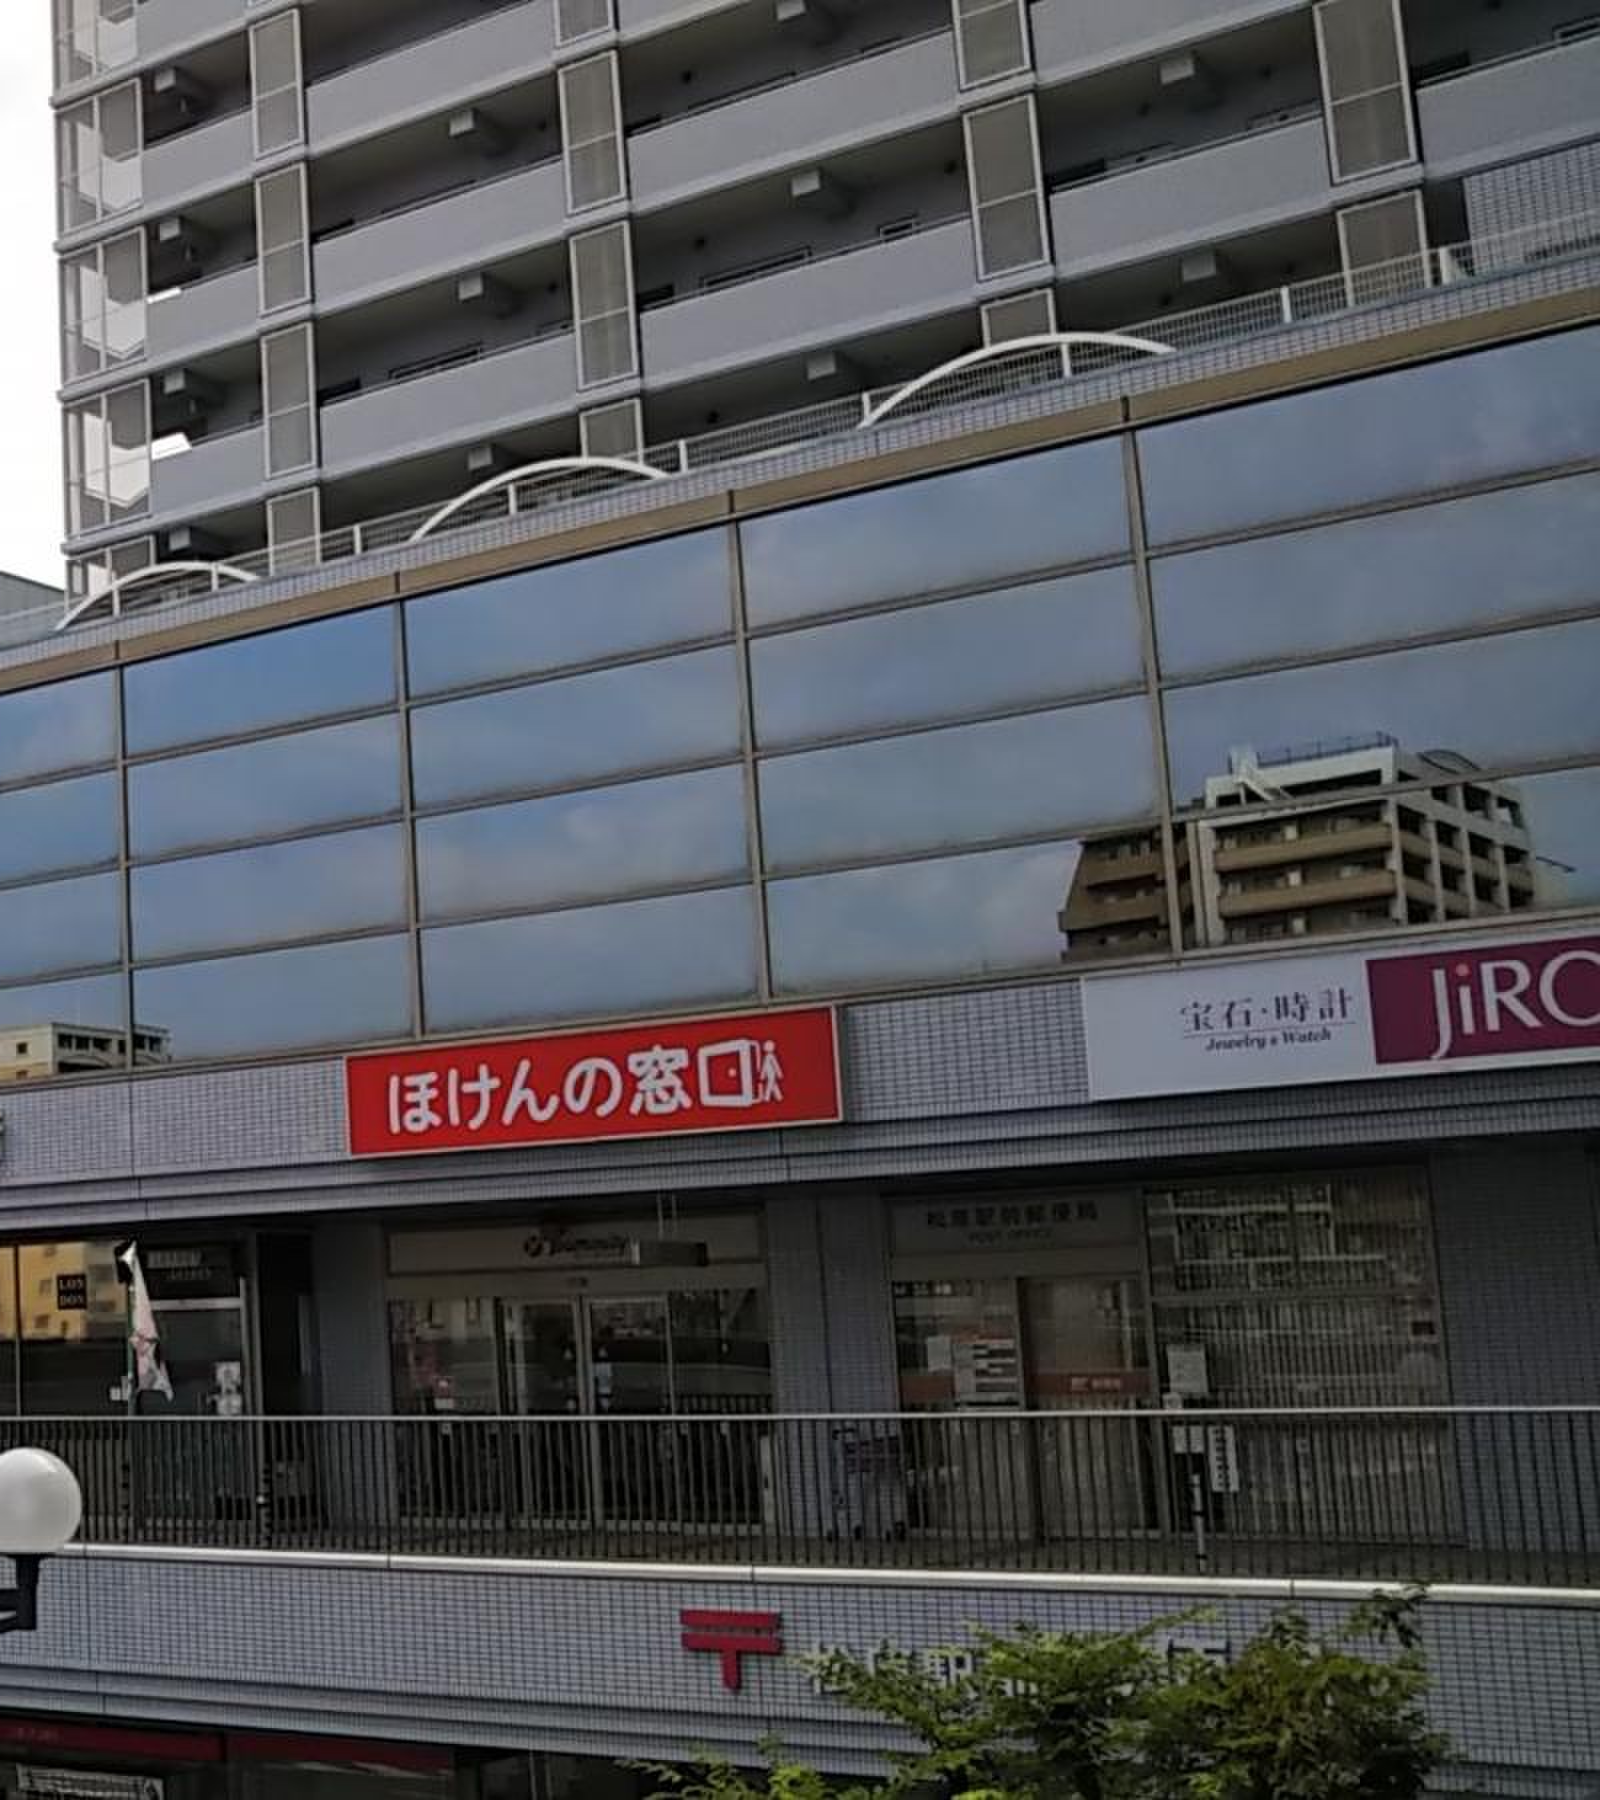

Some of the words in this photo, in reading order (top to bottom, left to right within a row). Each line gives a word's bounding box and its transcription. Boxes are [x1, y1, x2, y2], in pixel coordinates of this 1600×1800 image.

[1180, 988, 1352, 1031] 宝石・時計
[1206, 1034, 1266, 1051] Jewelry
[1282, 1027, 1331, 1044] Watch
[388, 1038, 762, 1135] ほけんの窓口
